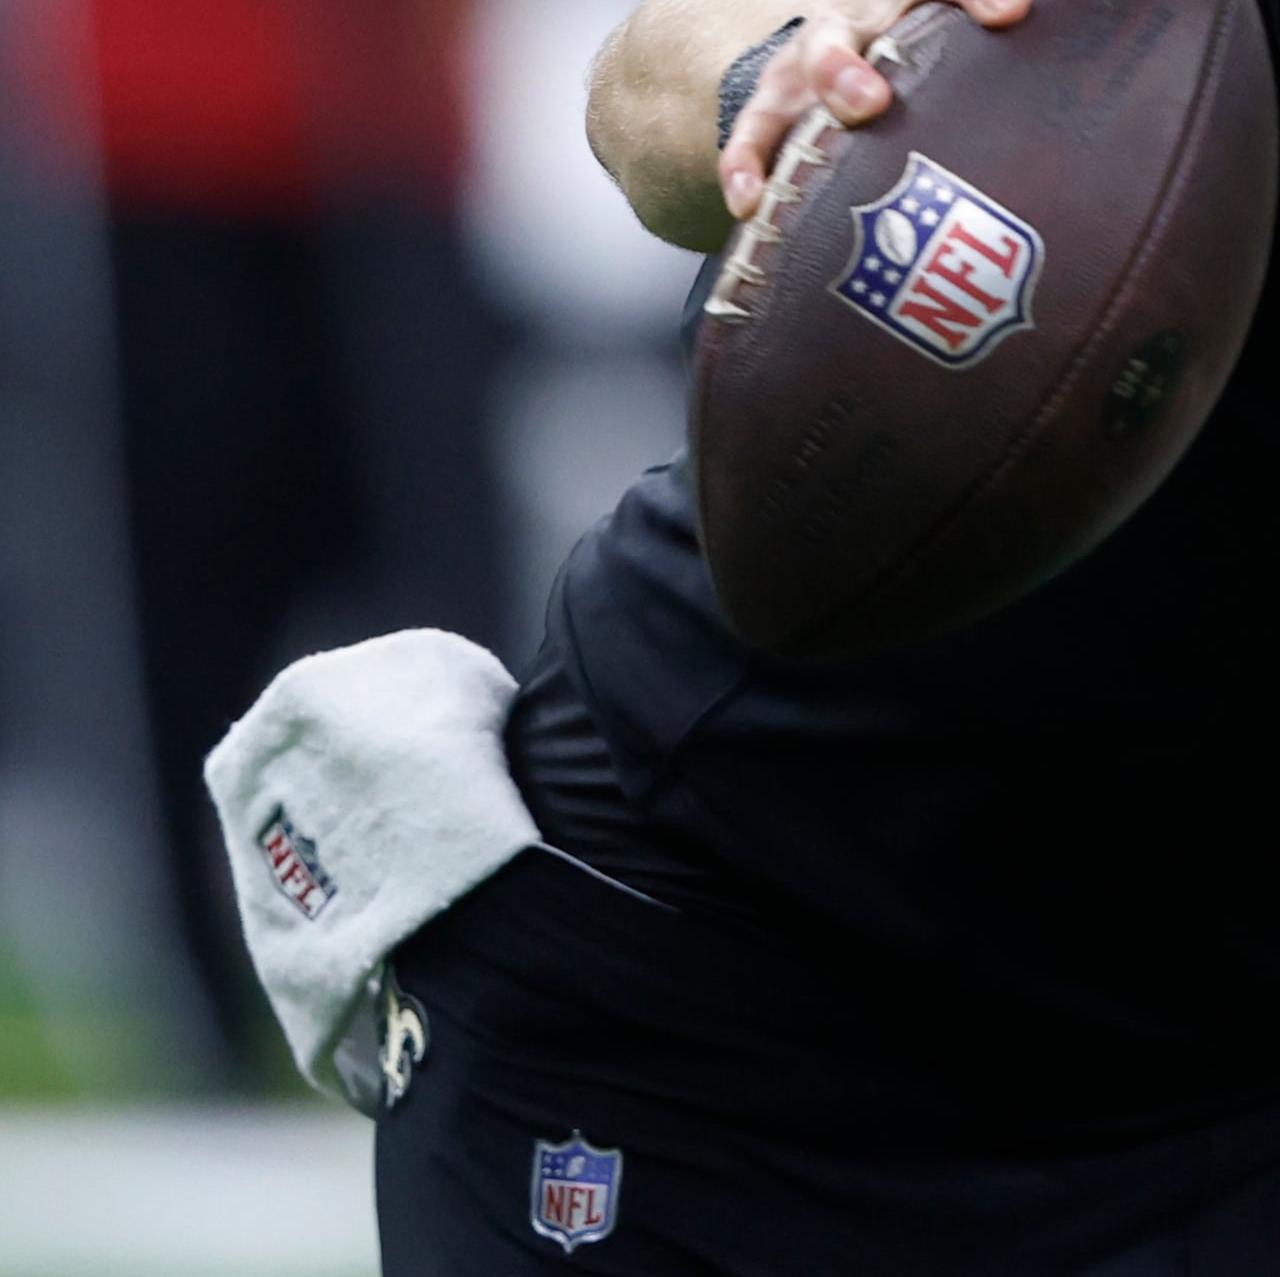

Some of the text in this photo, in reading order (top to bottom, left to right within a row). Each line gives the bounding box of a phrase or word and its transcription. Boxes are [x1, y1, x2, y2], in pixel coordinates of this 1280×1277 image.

[898, 222, 1021, 352] NFL
[267, 834, 317, 912] NFL
[544, 1183, 603, 1229] NFL
